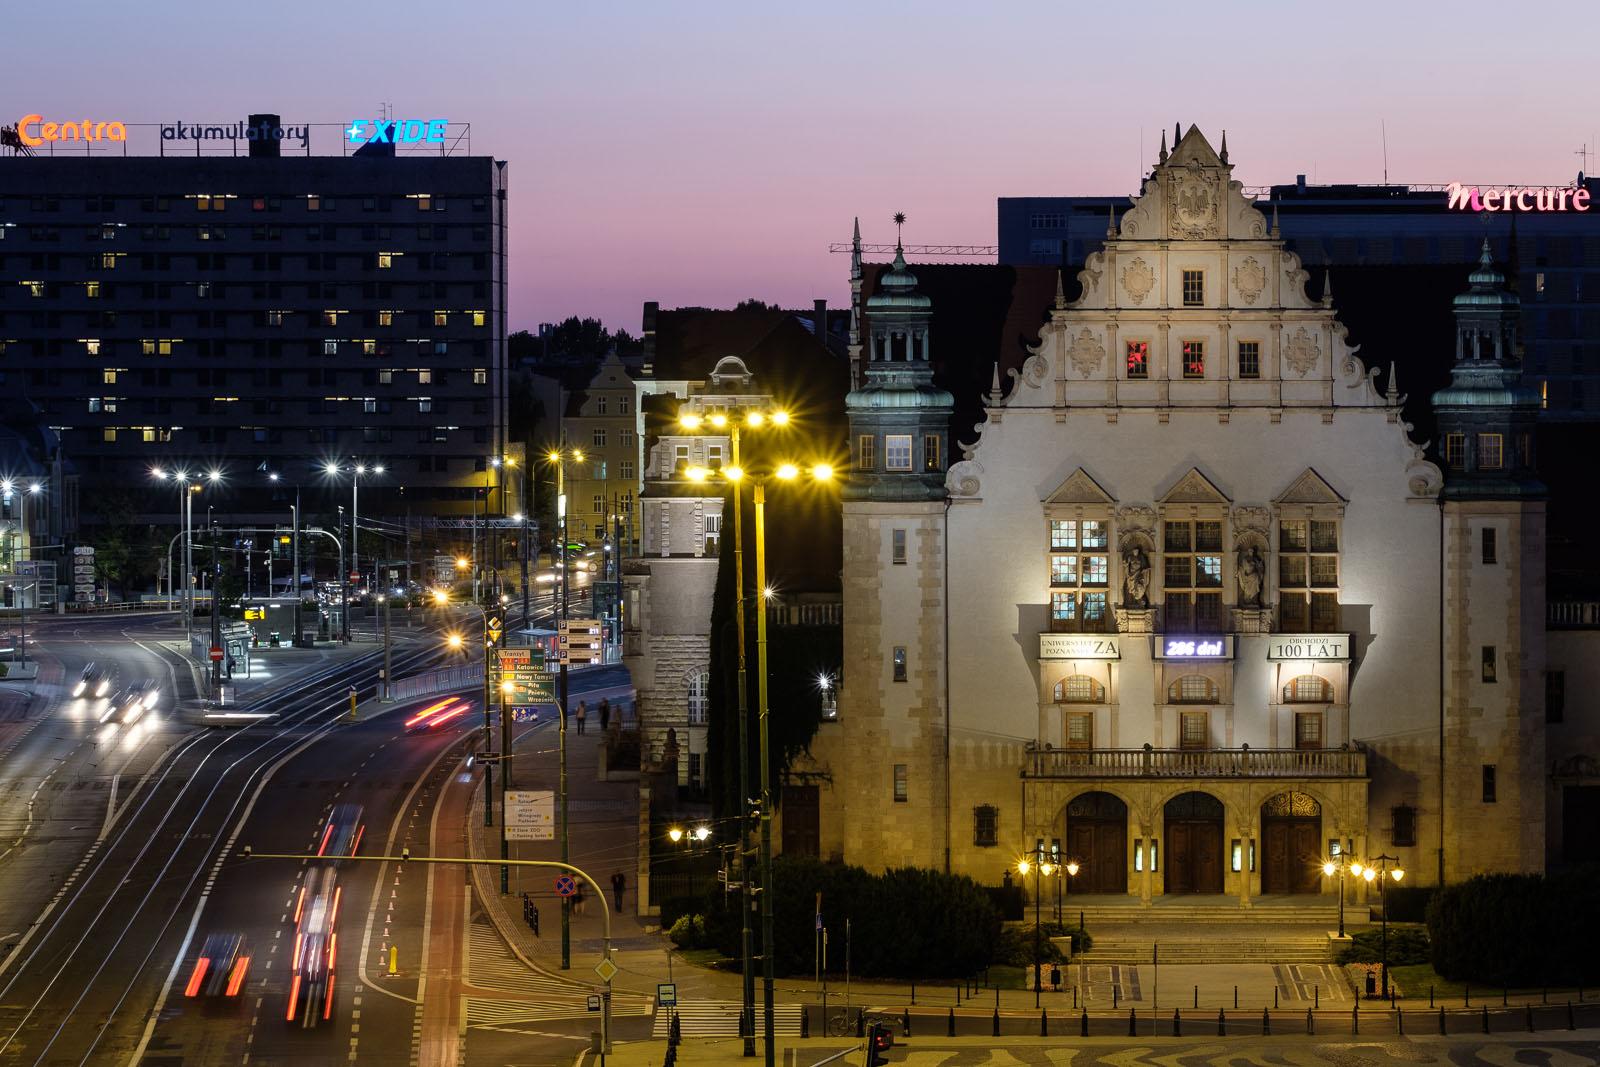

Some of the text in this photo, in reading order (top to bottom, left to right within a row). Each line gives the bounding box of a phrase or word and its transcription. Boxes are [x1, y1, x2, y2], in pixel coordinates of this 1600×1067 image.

[18, 114, 127, 146] Centra
[162, 120, 309, 148] akumulatory
[347, 119, 448, 143] EXIDE
[1094, 641, 1118, 654] ZA
[1196, 640, 1223, 656] dni
[1277, 644, 1342, 657] 100 LAT
